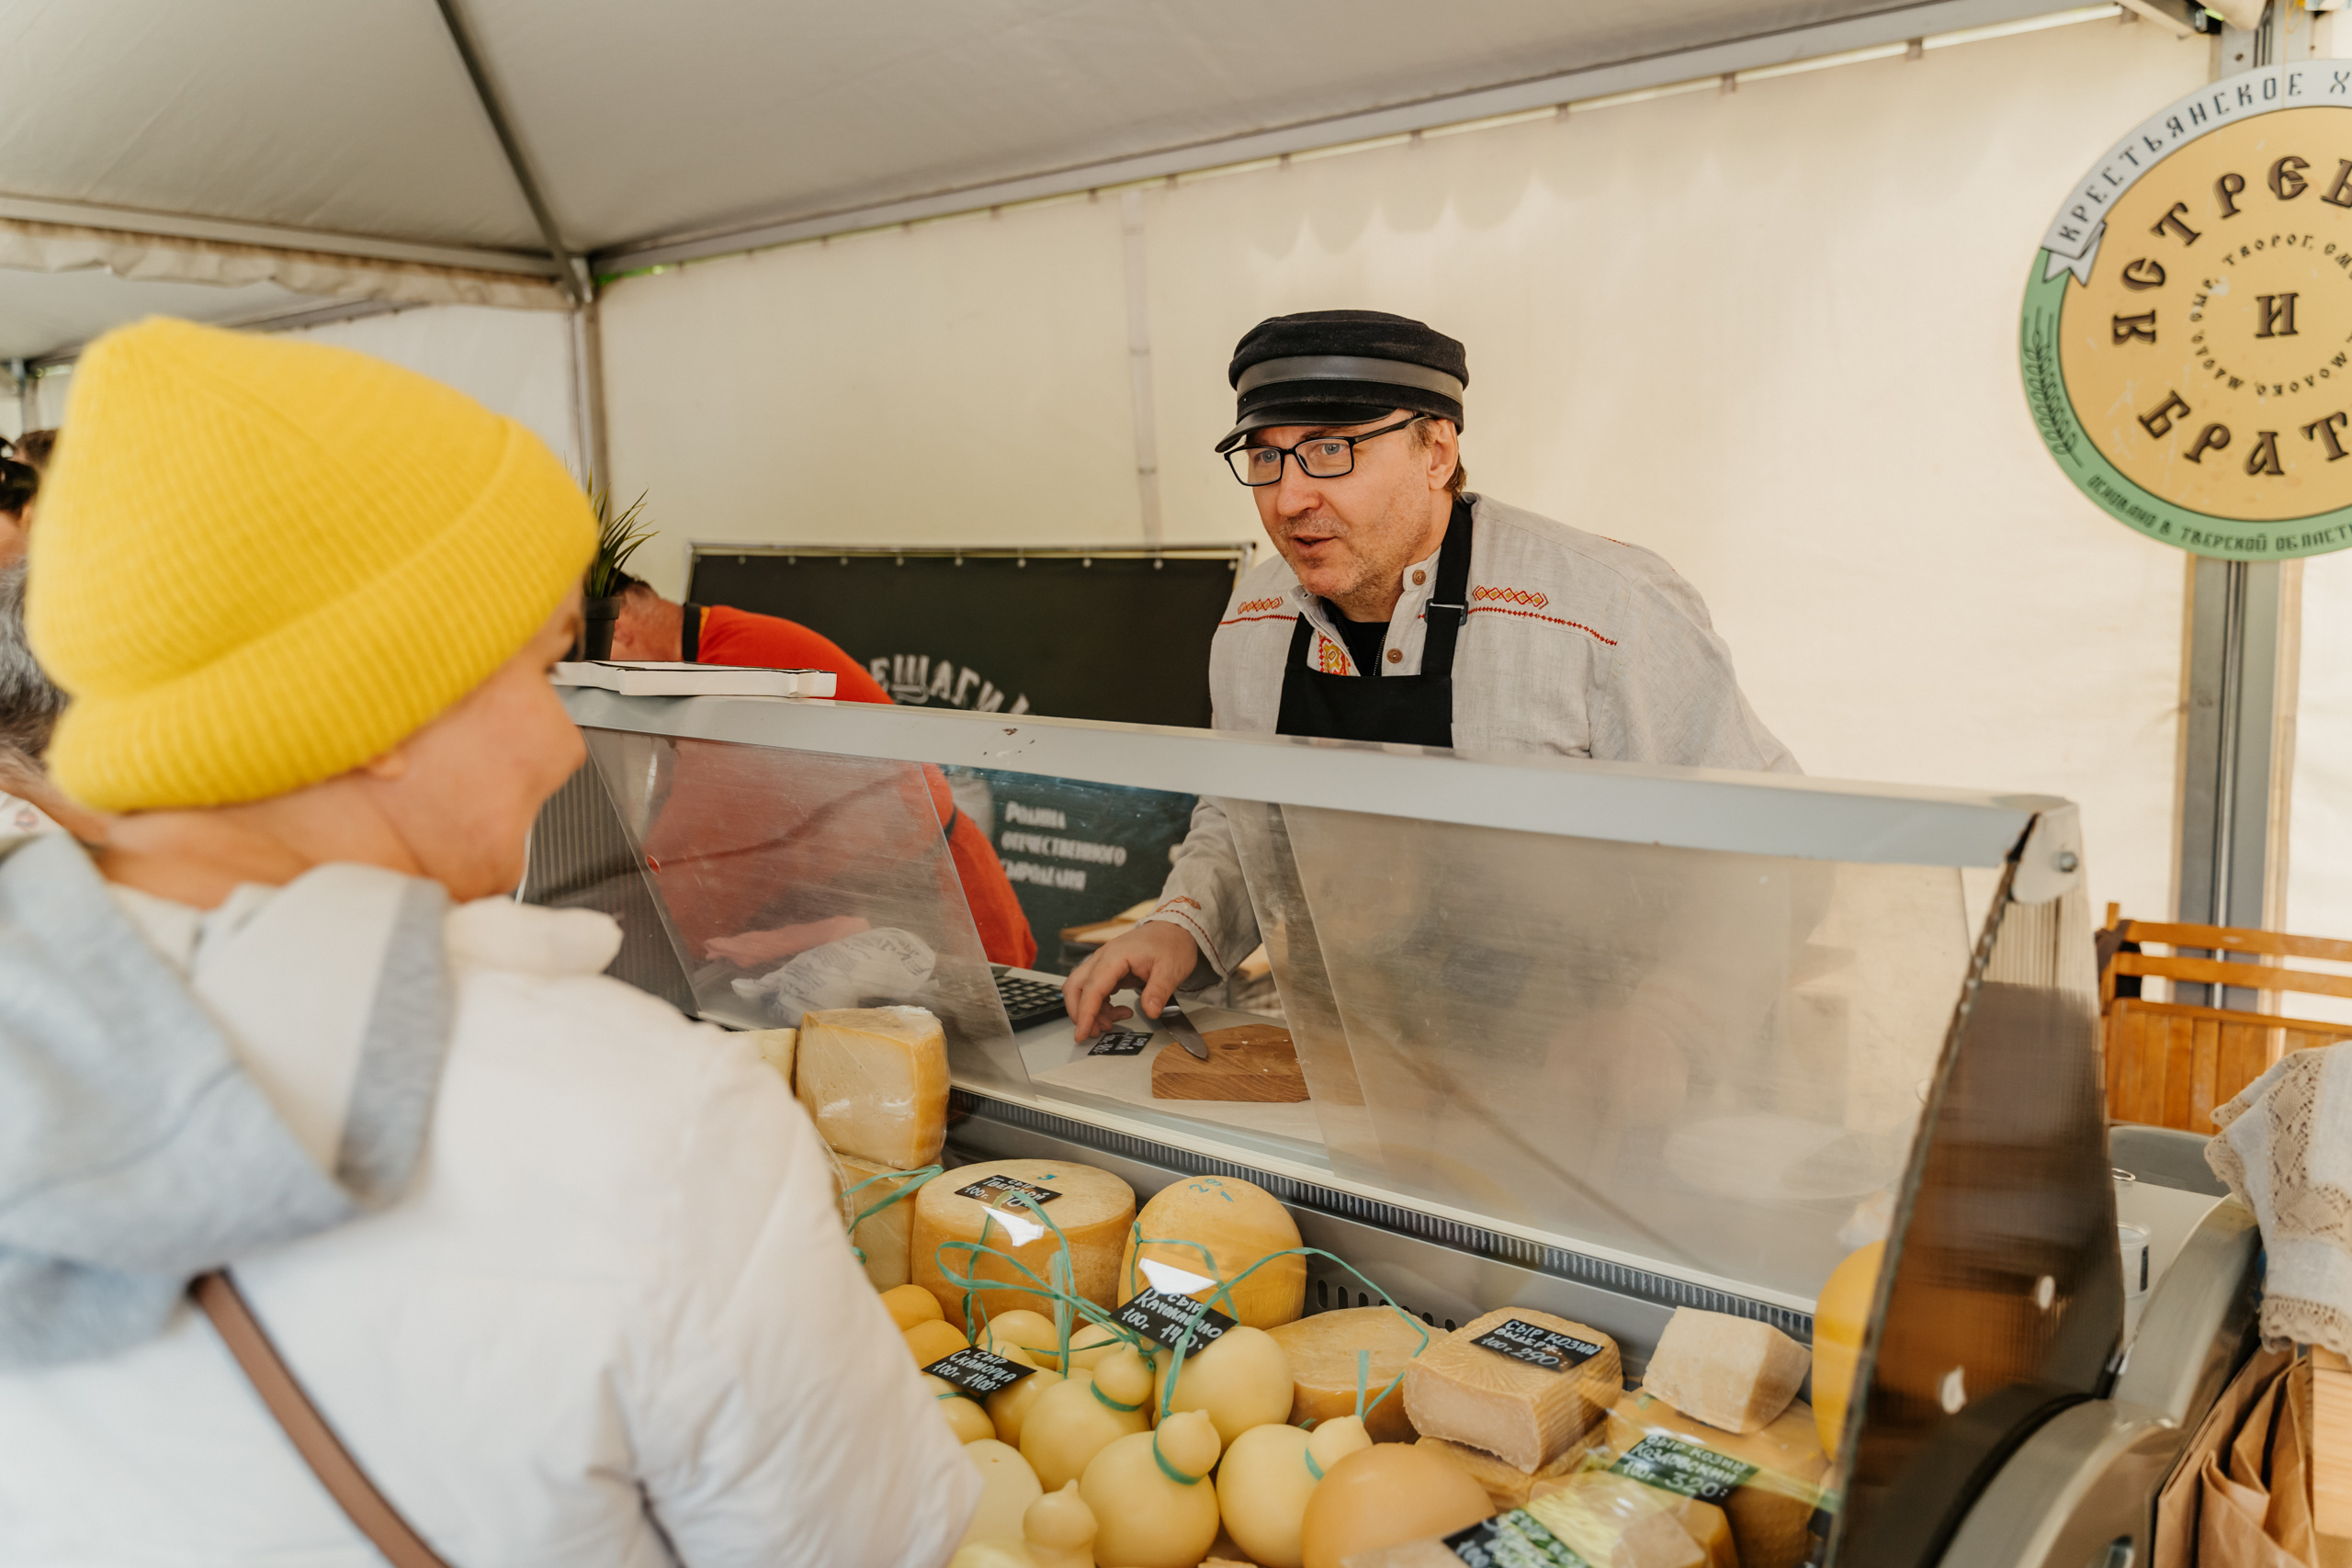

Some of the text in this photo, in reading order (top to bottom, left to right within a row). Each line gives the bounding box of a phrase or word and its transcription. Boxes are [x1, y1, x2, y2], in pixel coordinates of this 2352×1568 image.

[2058, 73, 2303, 243] КРЕСТЬЯНСКОЕ
[2253, 292, 2300, 339] И
[2137, 389, 2349, 476] БРАТ
[2180, 525, 2267, 553] ТВЕРСКОЙ
